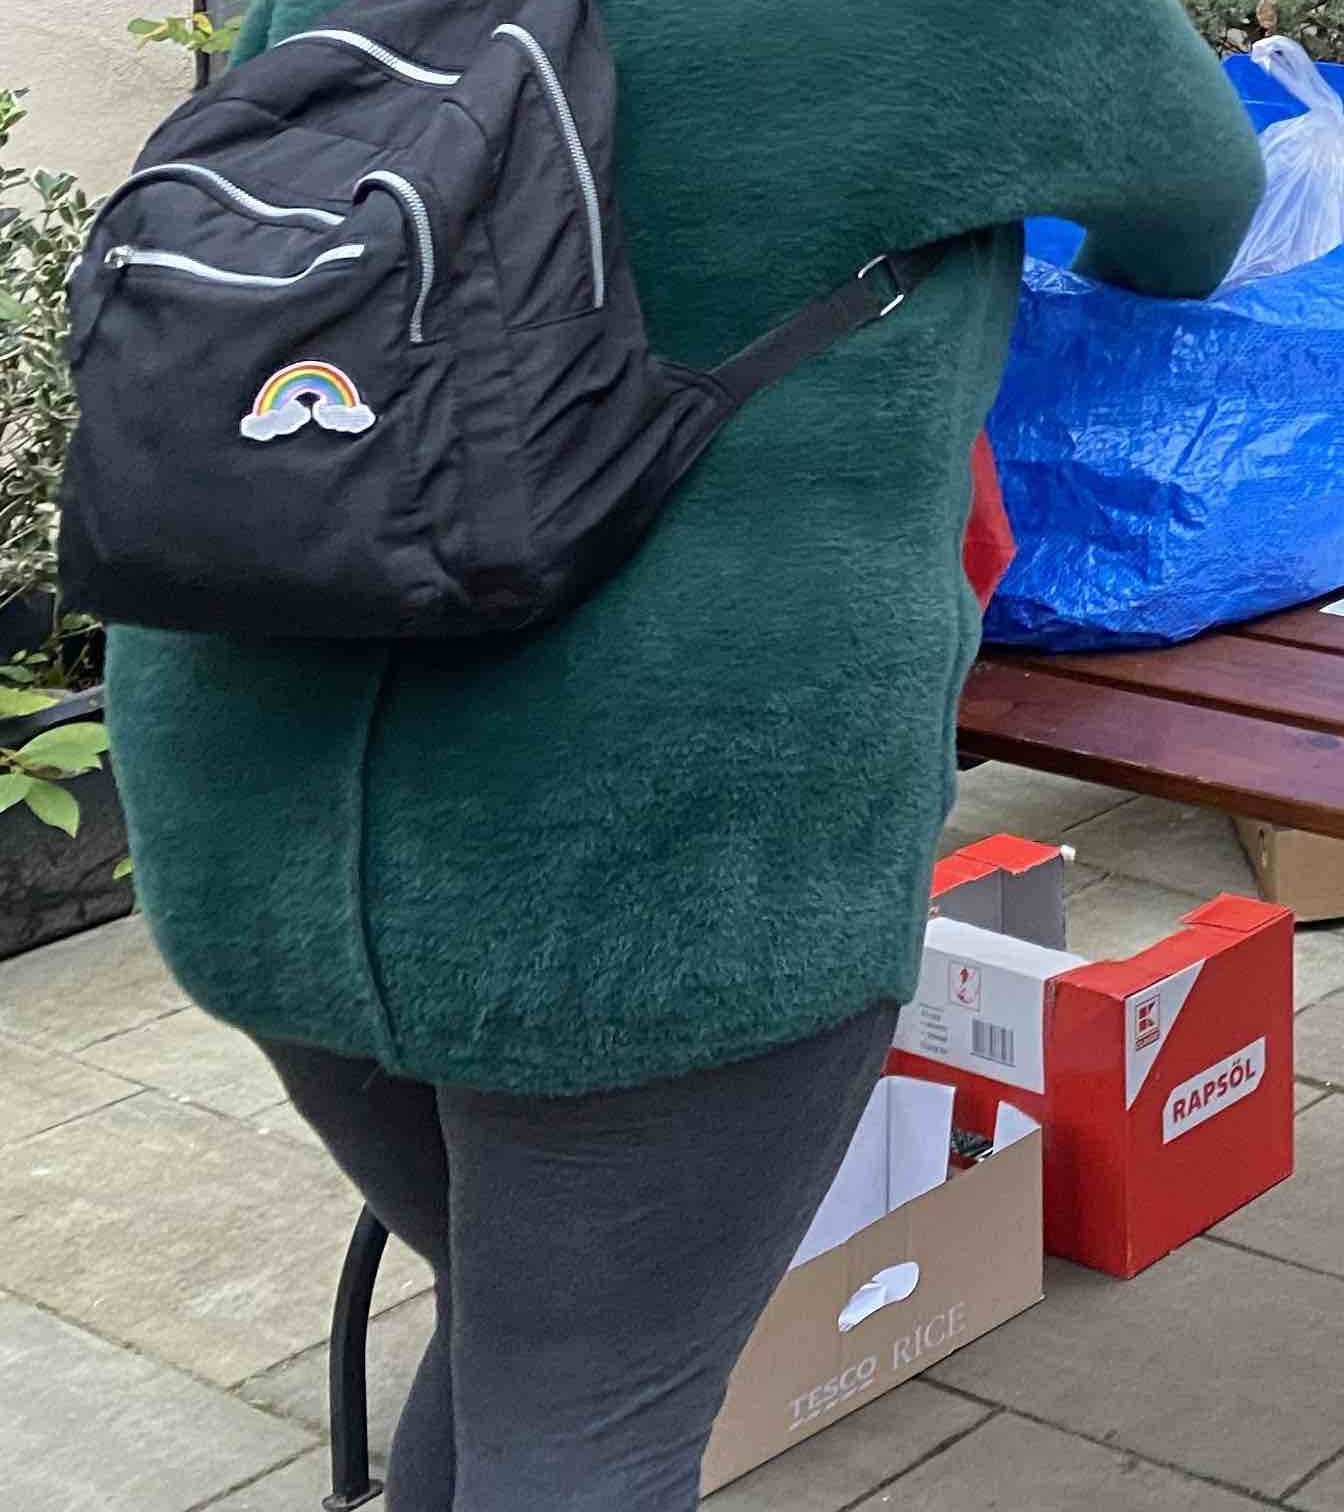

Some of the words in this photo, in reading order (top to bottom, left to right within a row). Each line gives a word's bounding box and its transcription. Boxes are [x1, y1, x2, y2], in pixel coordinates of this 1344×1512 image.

[1172, 1058, 1257, 1124] RAPSÖL
[788, 1355, 877, 1428] TESCO
[892, 1301, 967, 1371] RICE
